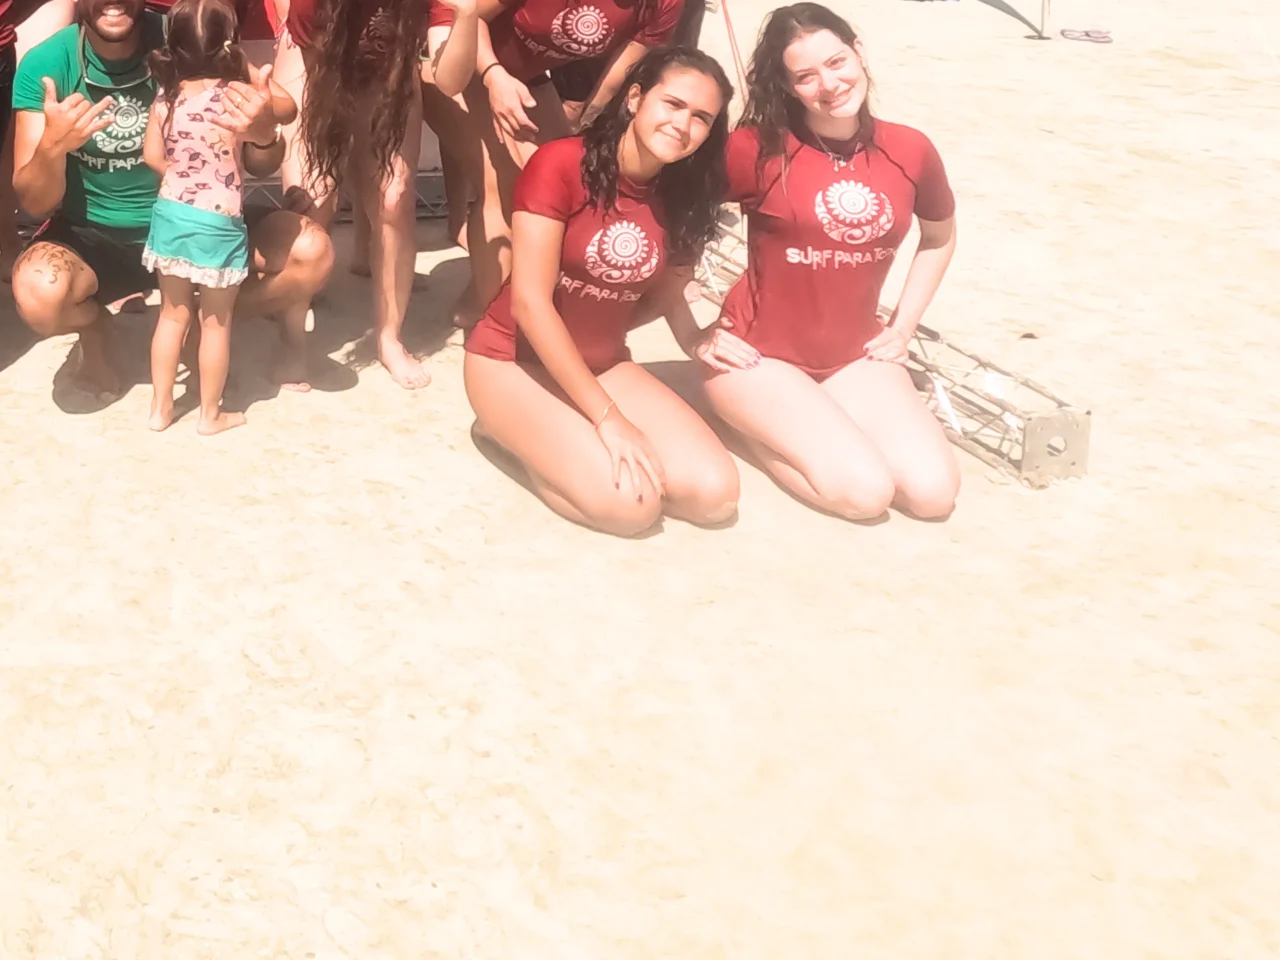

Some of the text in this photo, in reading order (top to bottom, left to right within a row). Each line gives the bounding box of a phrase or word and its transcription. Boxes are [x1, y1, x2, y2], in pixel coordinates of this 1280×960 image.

[785, 246, 832, 270] SURF
[834, 250, 872, 269] PARA
[580, 284, 619, 302] PARA
